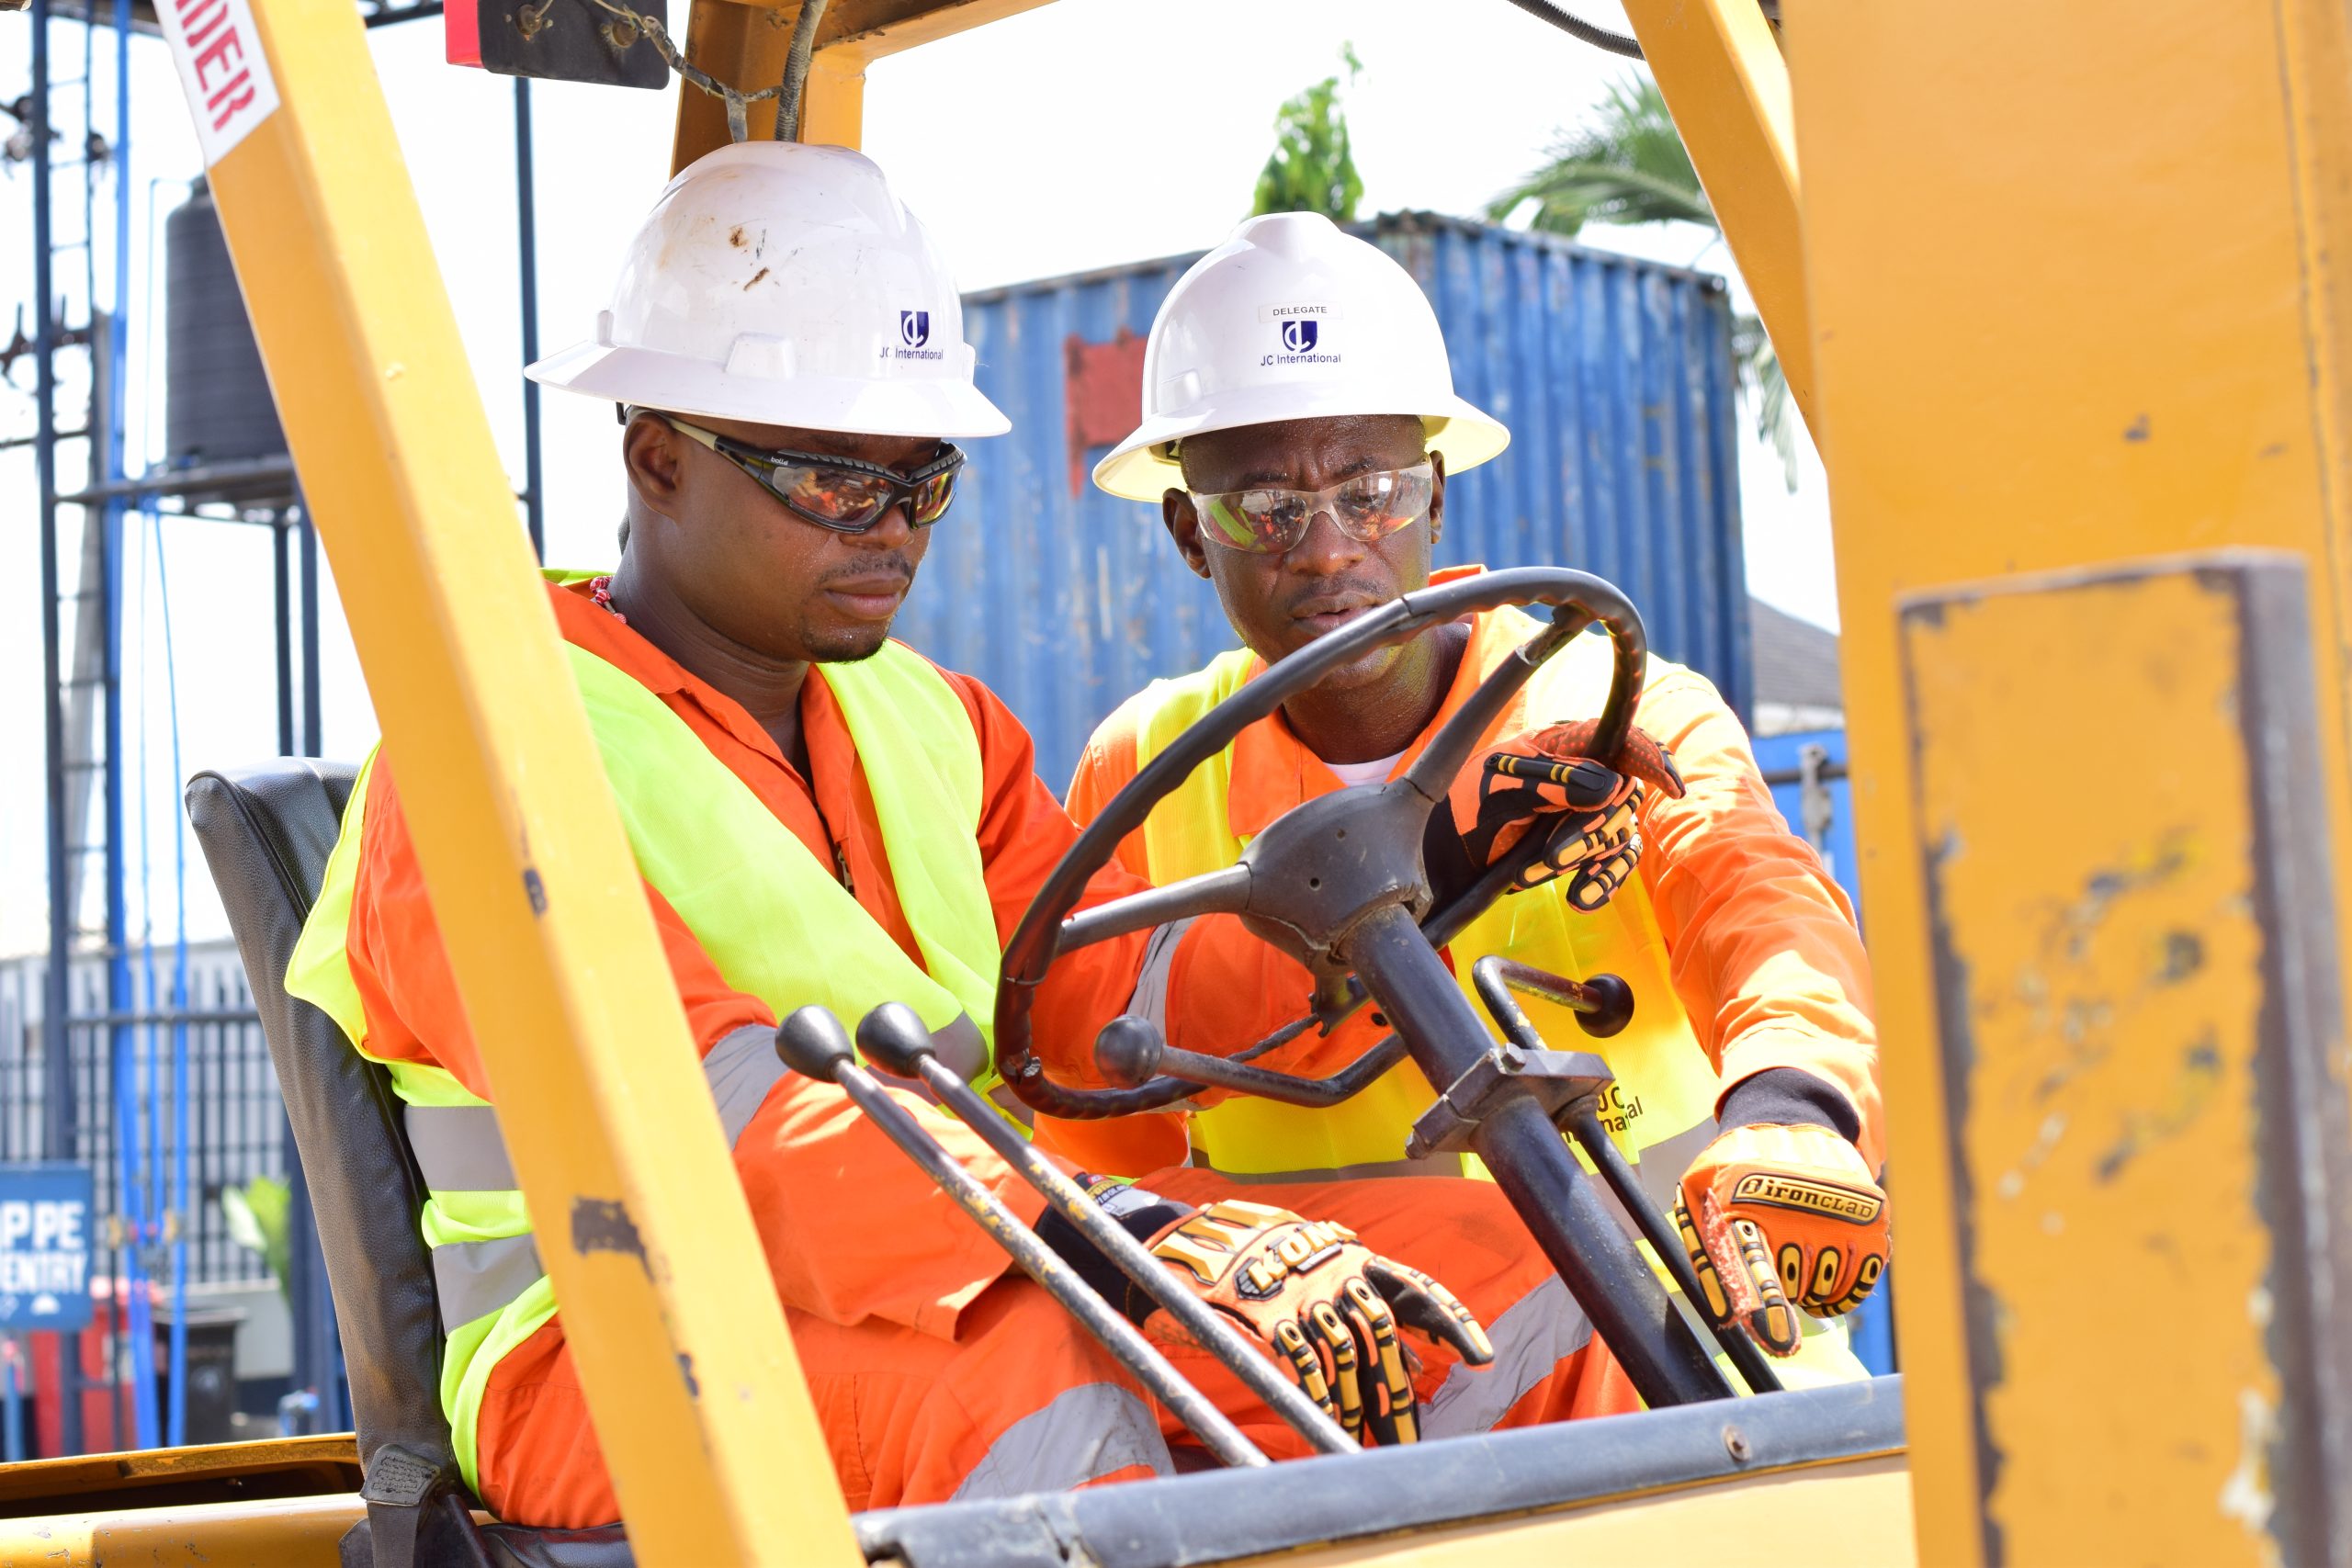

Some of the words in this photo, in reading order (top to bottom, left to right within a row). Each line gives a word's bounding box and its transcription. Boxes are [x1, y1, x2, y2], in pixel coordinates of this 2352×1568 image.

[175, 0, 255, 132] DER
[1272, 306, 1329, 317] DELEGATE
[895, 347, 944, 360] International
[1261, 355, 1273, 367] JC
[1277, 353, 1341, 365] International
